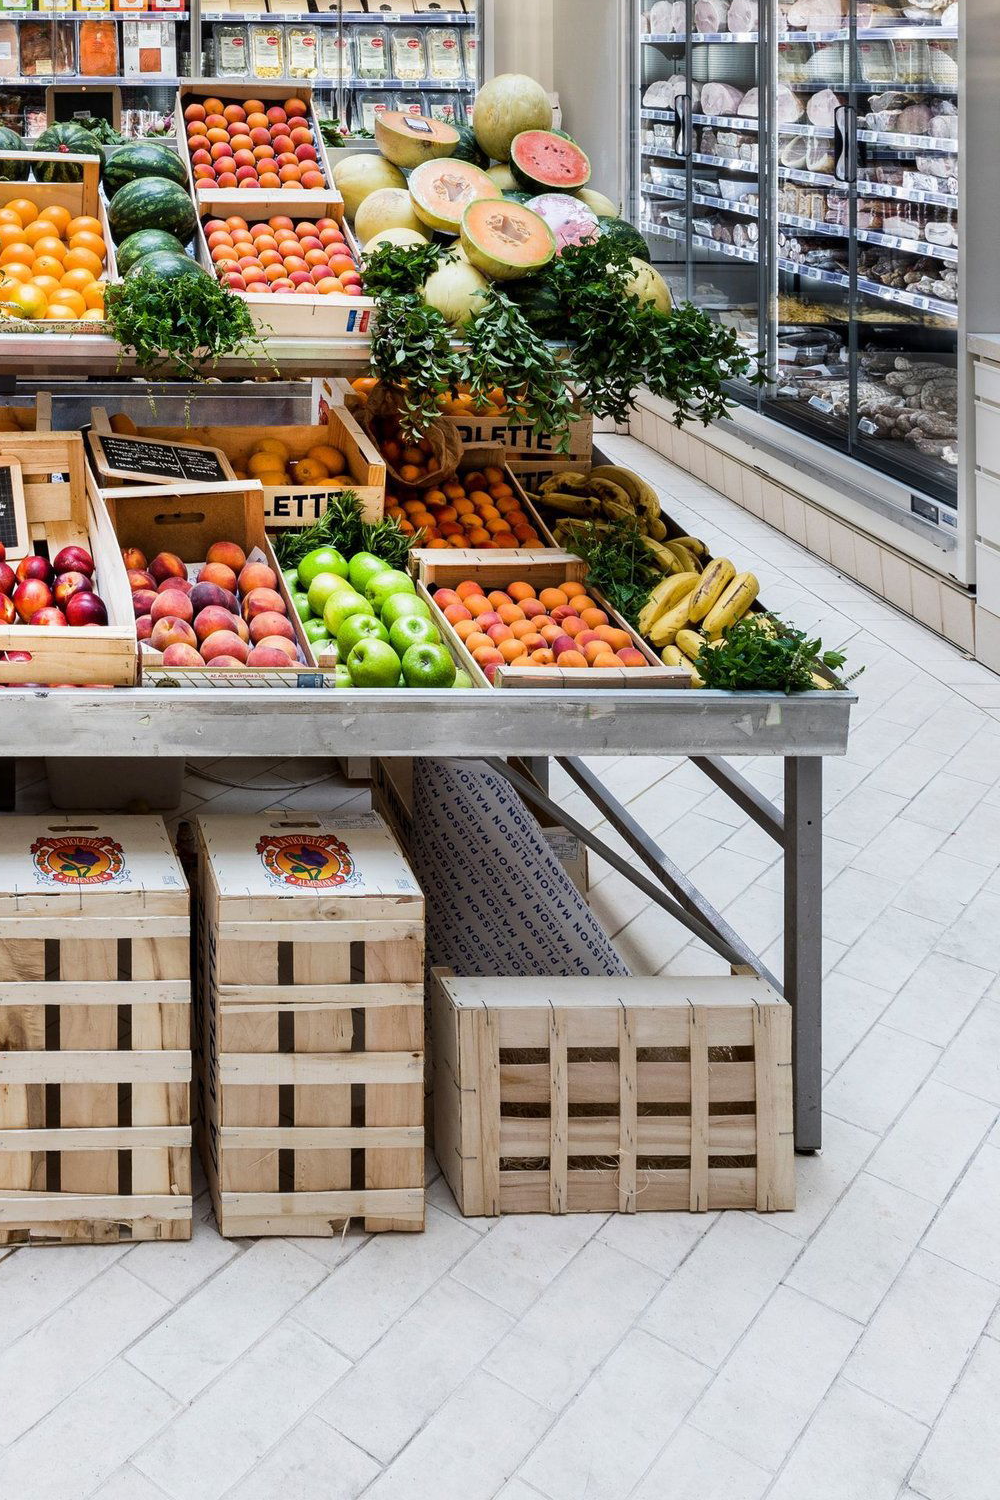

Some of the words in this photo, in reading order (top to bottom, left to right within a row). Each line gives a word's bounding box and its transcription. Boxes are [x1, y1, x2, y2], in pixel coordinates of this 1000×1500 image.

[50, 841, 64, 849] LA
[63, 837, 102, 849] VIOLETTE
[272, 840, 288, 849] LA
[285, 836, 329, 848] VIOLETTE
[439, 801, 479, 854] PLISSON
[453, 795, 491, 844] MAISON
[491, 814, 533, 867] PLISSON
[505, 806, 544, 855] MAISON
[63, 876, 104, 884] ALMENARA
[296, 878, 338, 887] ALMENARA
[428, 840, 464, 891] MAISON
[439, 832, 479, 885] PLISSON
[478, 857, 516, 907] MAISON
[491, 846, 533, 900] PLISSON
[543, 856, 583, 910] PLISSON
[429, 870, 464, 921] MAISON
[479, 888, 517, 938] MAISON
[532, 869, 572, 919] MAISON
[422, 914, 453, 960] PLISSO
[463, 894, 504, 947] PLISSON
[517, 910, 559, 964] PLISSON
[532, 903, 573, 954] MAISON
[452, 934, 482, 974] AISON
[464, 924, 505, 978] PLISSON
[571, 921, 614, 976] PLISSON
